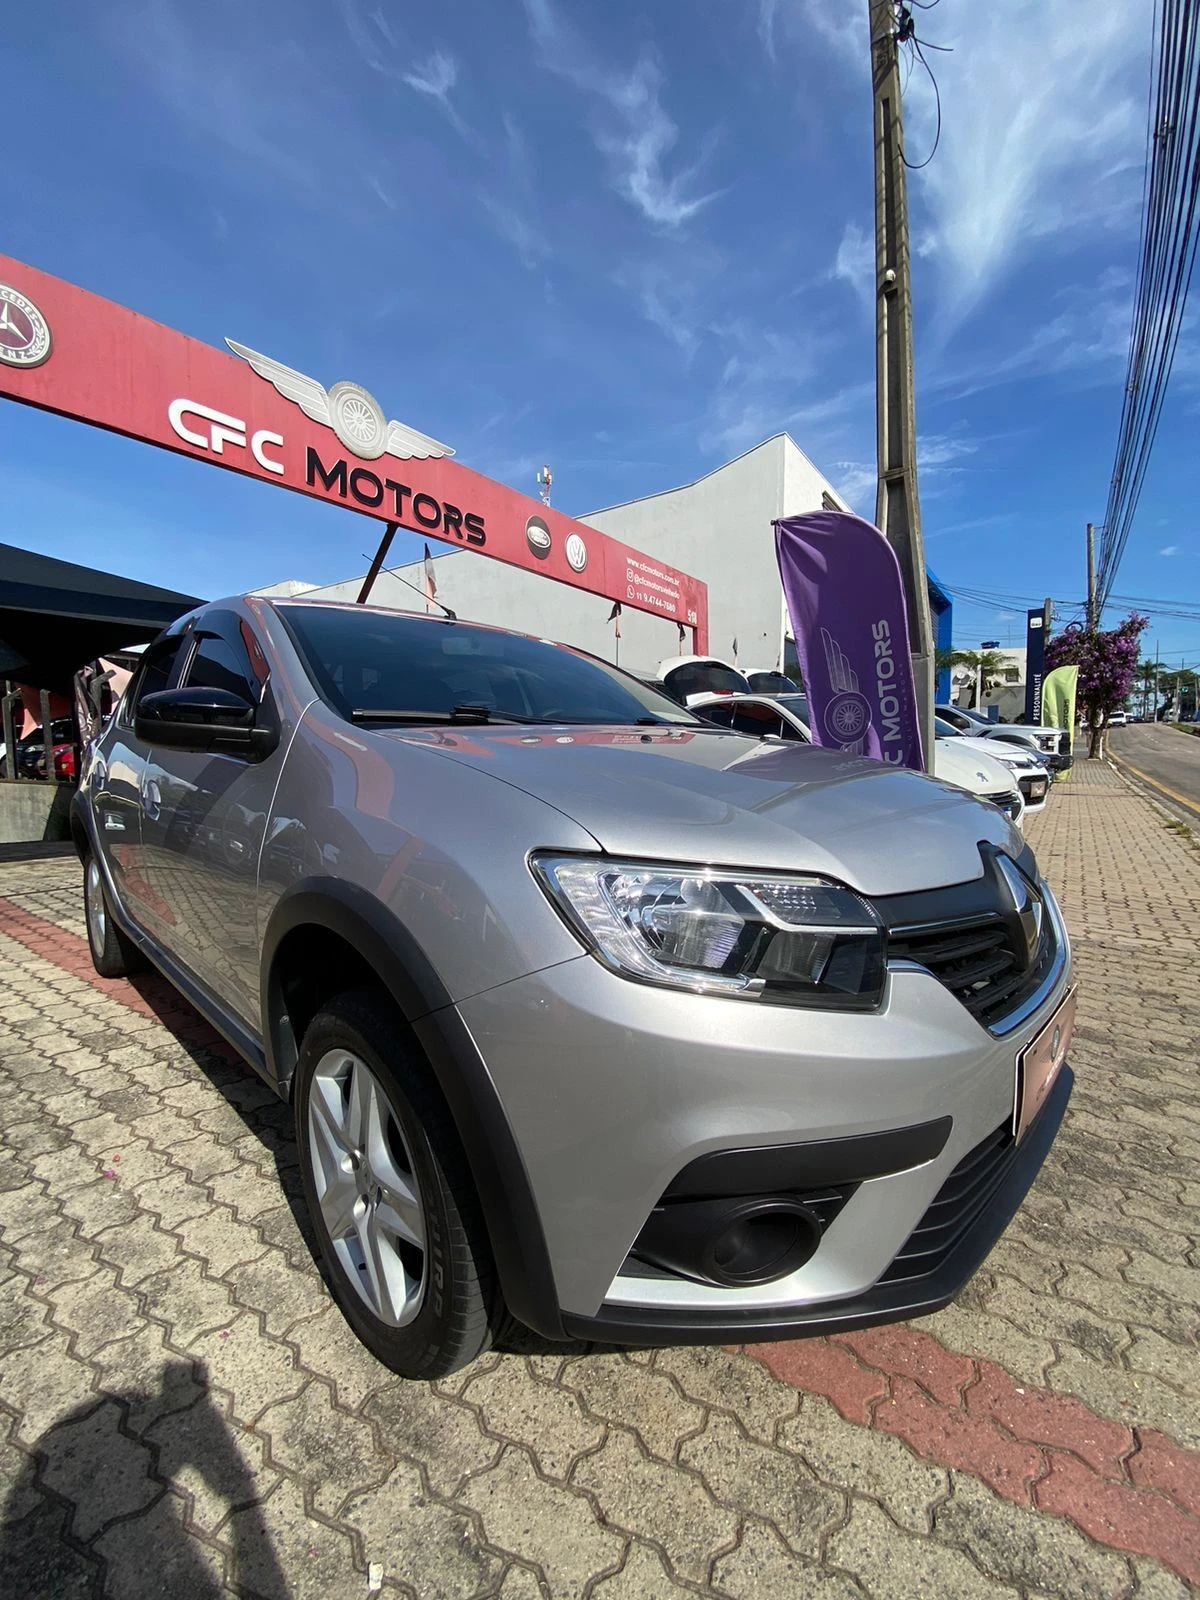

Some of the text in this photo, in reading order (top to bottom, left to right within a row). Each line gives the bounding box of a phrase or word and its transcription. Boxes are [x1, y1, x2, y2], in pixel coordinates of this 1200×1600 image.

[0, 290, 38, 320] CEDES
[168, 399, 486, 547] CFC MOTORS
[871, 619, 901, 742] MOTORS
[1033, 674, 1041, 720] PERSONNALITÉ
